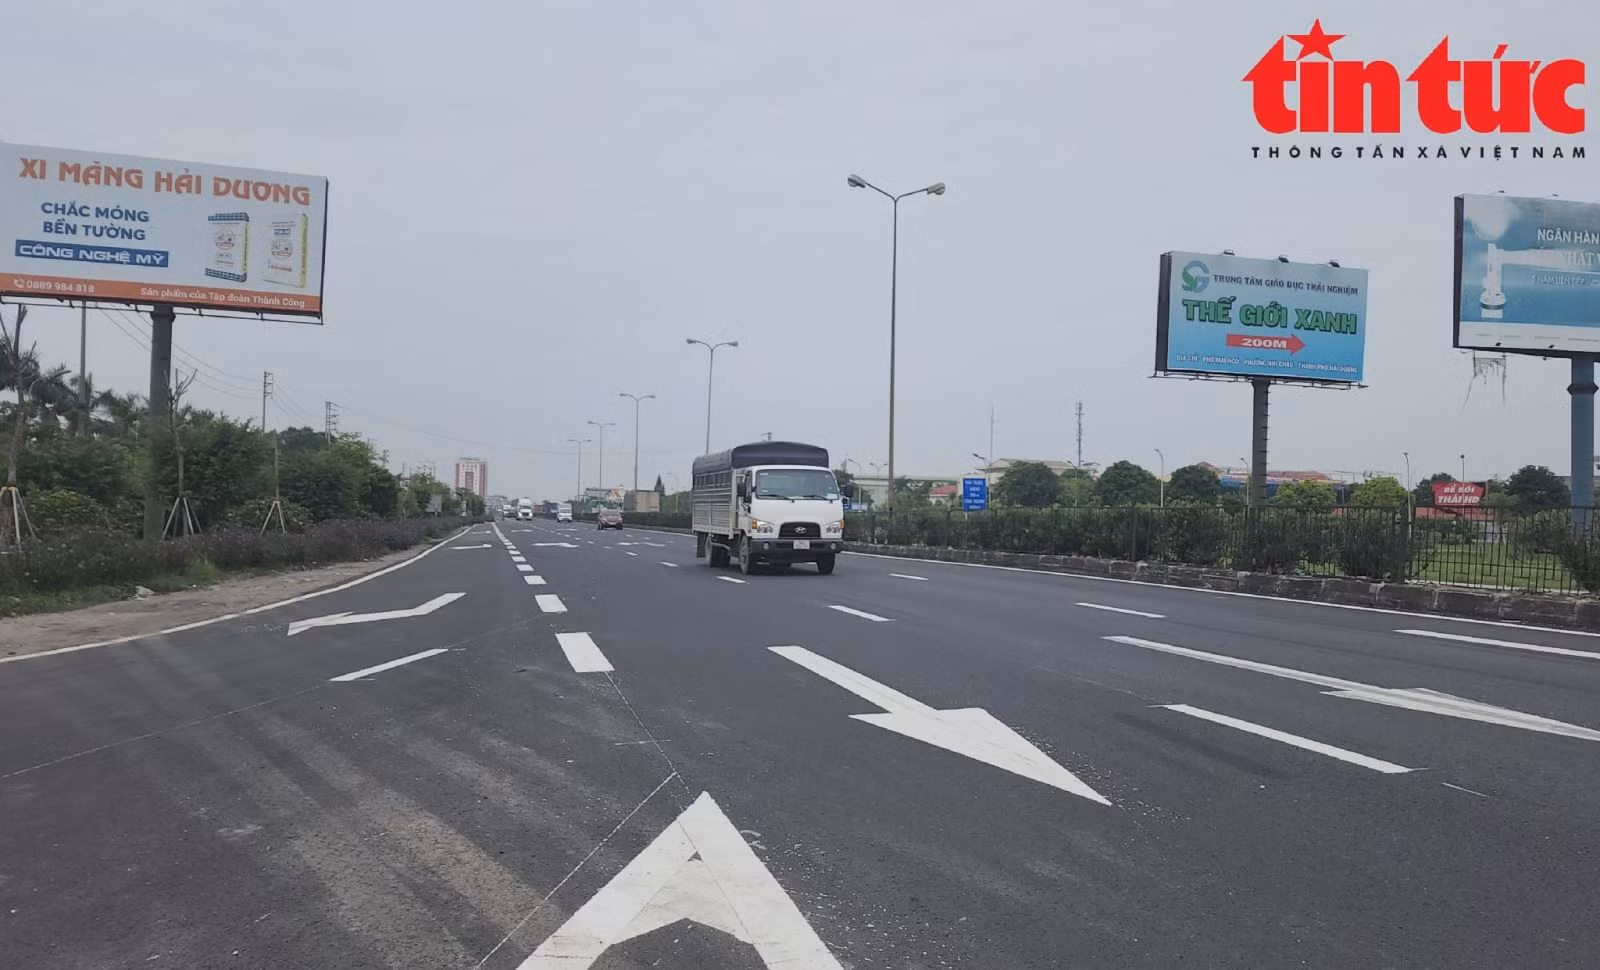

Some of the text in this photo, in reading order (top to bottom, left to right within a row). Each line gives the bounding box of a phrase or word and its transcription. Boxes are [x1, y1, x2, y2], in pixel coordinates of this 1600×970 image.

[19, 158, 310, 206] XI MĂNG HẢI DƯƠNG
[41, 201, 149, 222] CHẮC MÓNG
[43, 218, 146, 241] BỀN TƯỜNG
[1537, 227, 1572, 242] NGÂN
[19, 244, 74, 258] CÔNG
[79, 249, 130, 265] NGHỆ
[26, 280, 52, 290] 0889
[54, 283, 73, 291] 984
[1213, 274, 1243, 285] TRUNG
[1244, 276, 1263, 287] TÂM
[282, 297, 305, 309] Công
[1182, 296, 1357, 335] THẾ GIỚI XANH
[1242, 338, 1287, 349] 200M
